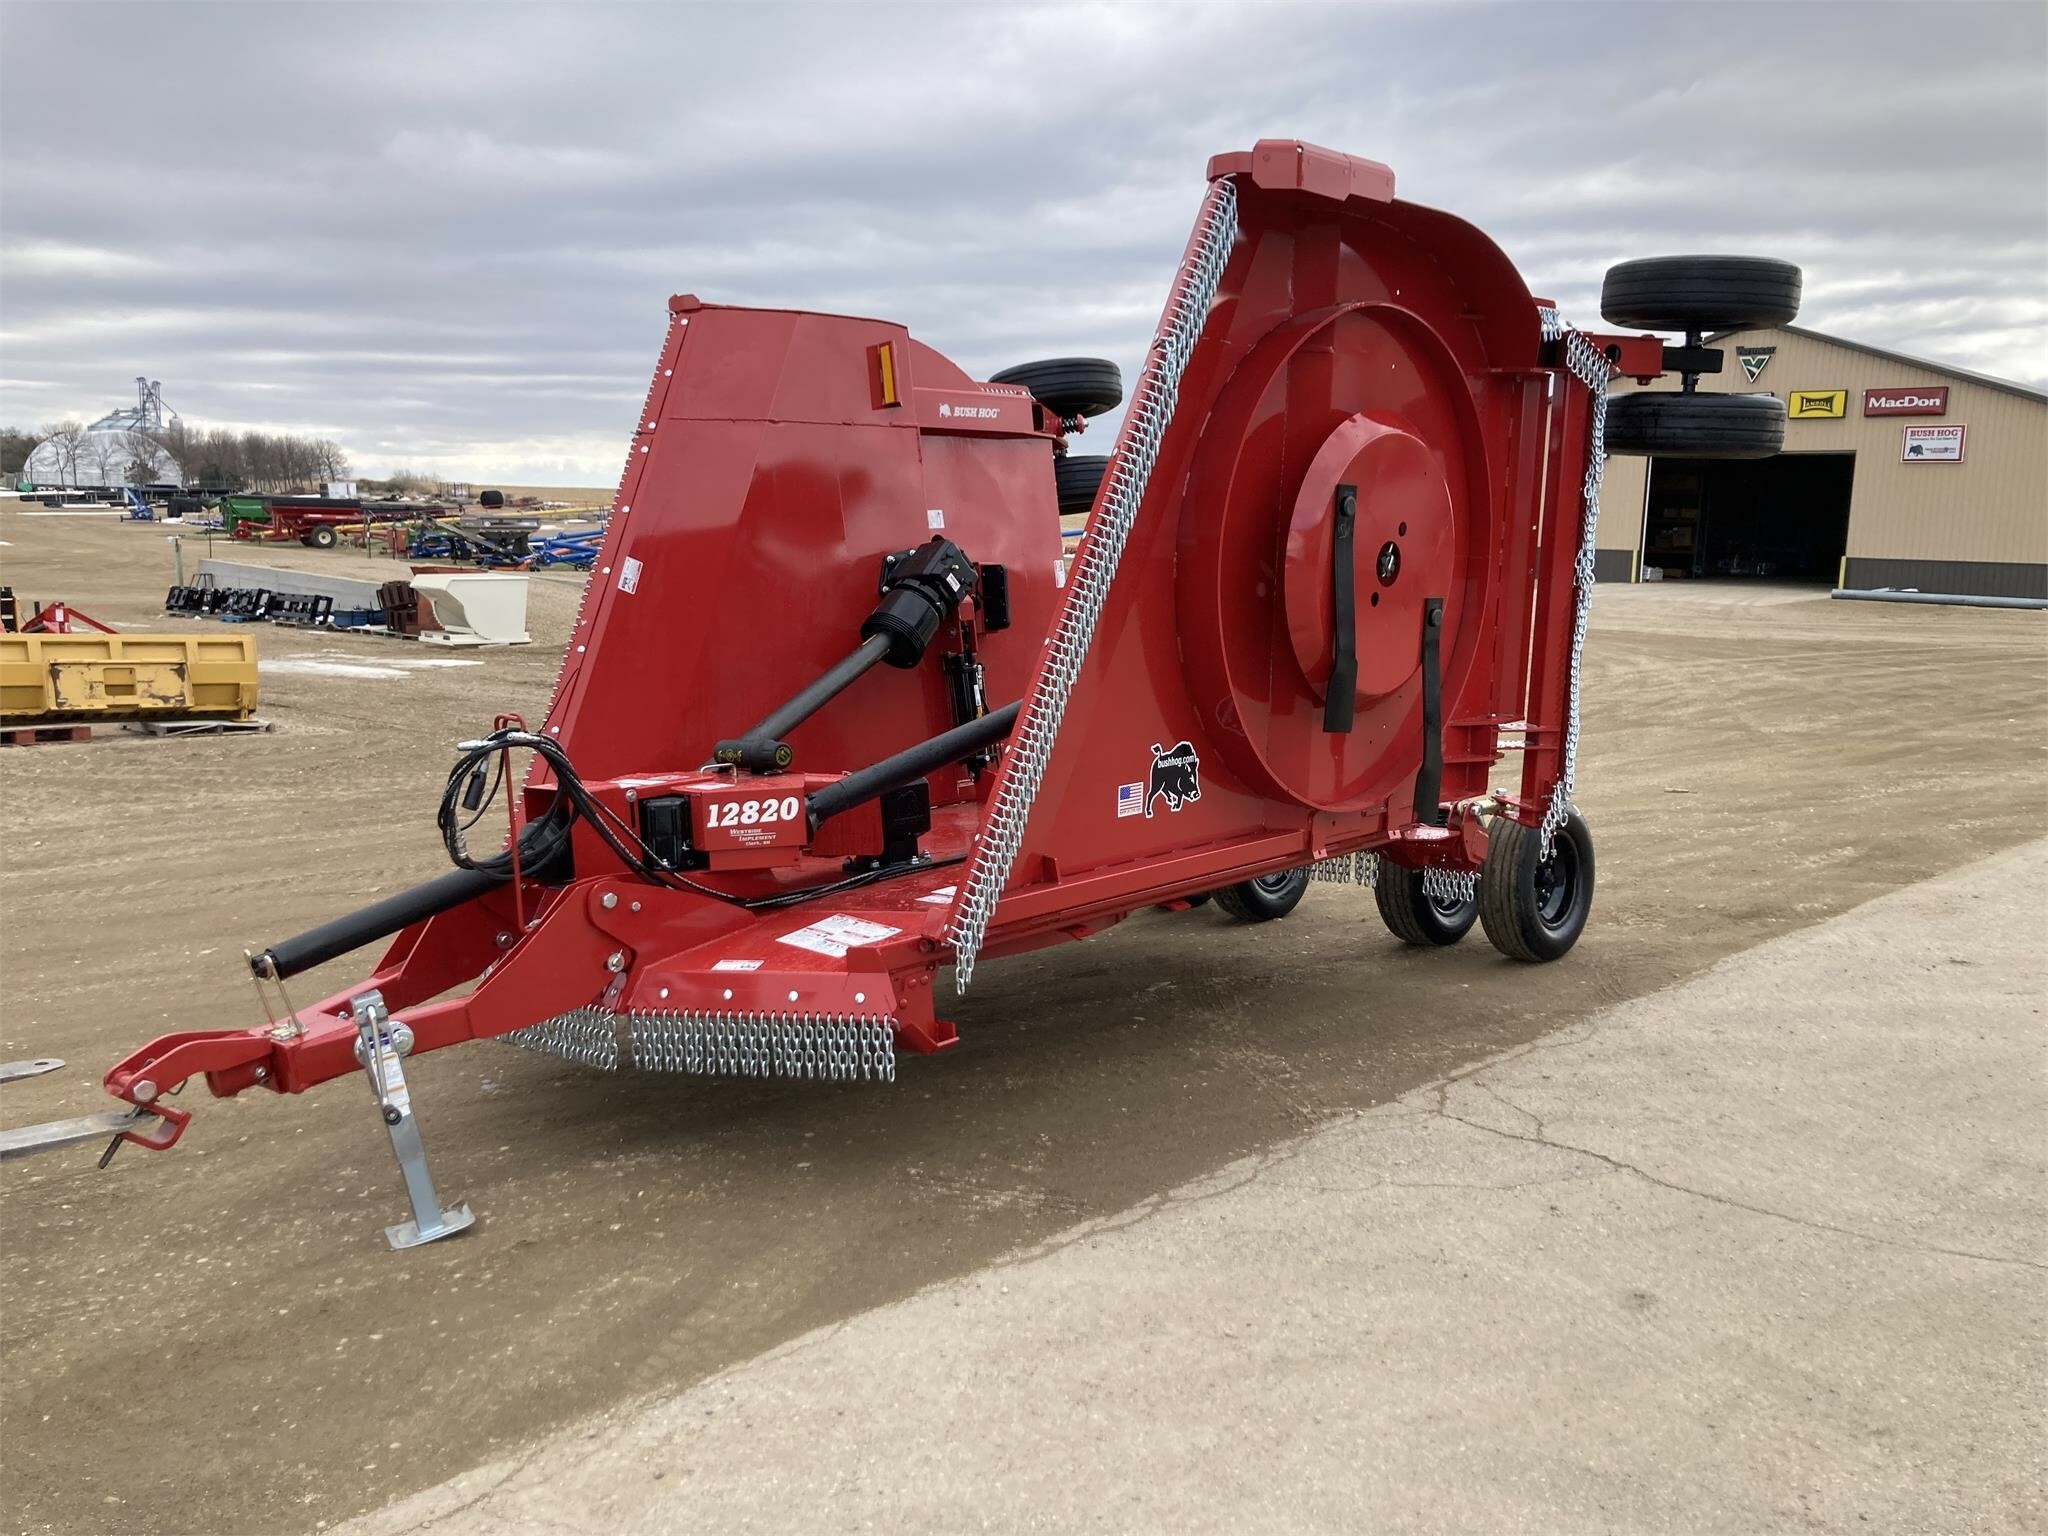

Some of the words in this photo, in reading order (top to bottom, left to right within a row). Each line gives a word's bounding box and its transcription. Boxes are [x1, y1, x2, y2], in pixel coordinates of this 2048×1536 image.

[1869, 396, 1941, 408] MacDon
[953, 406, 977, 417] BUSH
[978, 408, 998, 418] HOG
[1937, 429, 1958, 437] HOG
[1157, 755, 1195, 768] bushhog.com
[707, 797, 799, 827] 12820
